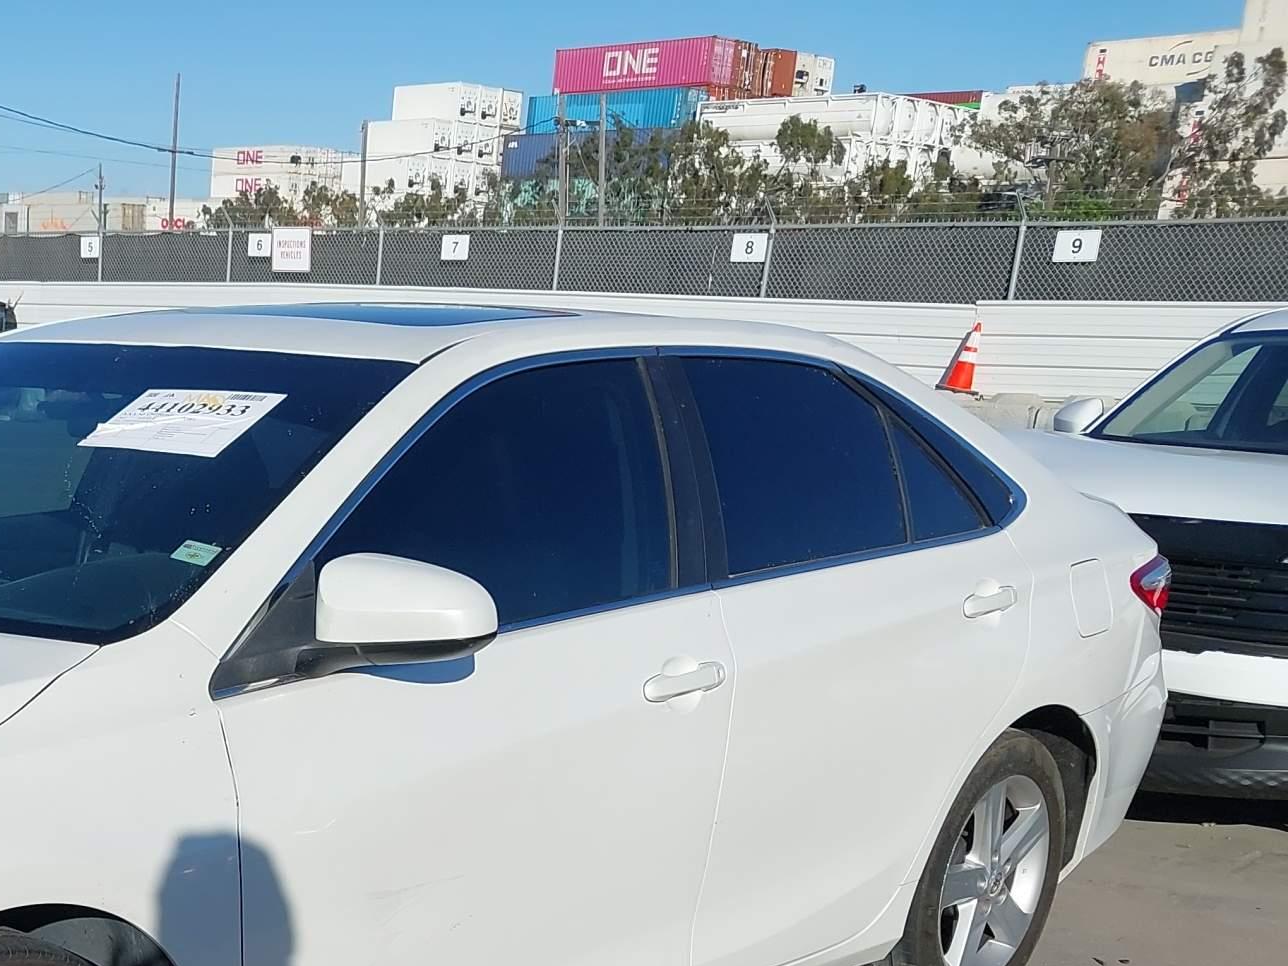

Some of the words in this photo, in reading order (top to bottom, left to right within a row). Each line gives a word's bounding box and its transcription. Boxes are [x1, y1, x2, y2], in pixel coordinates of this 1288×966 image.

[603, 47, 659, 77] ONE
[1149, 54, 1186, 67] CMA
[237, 151, 263, 165] ONE
[236, 178, 262, 193] ONE
[87, 241, 94, 253] 5
[256, 239, 263, 251] 6
[452, 241, 459, 254] 7
[745, 240, 754, 254] 8
[1071, 238, 1083, 254] 9
